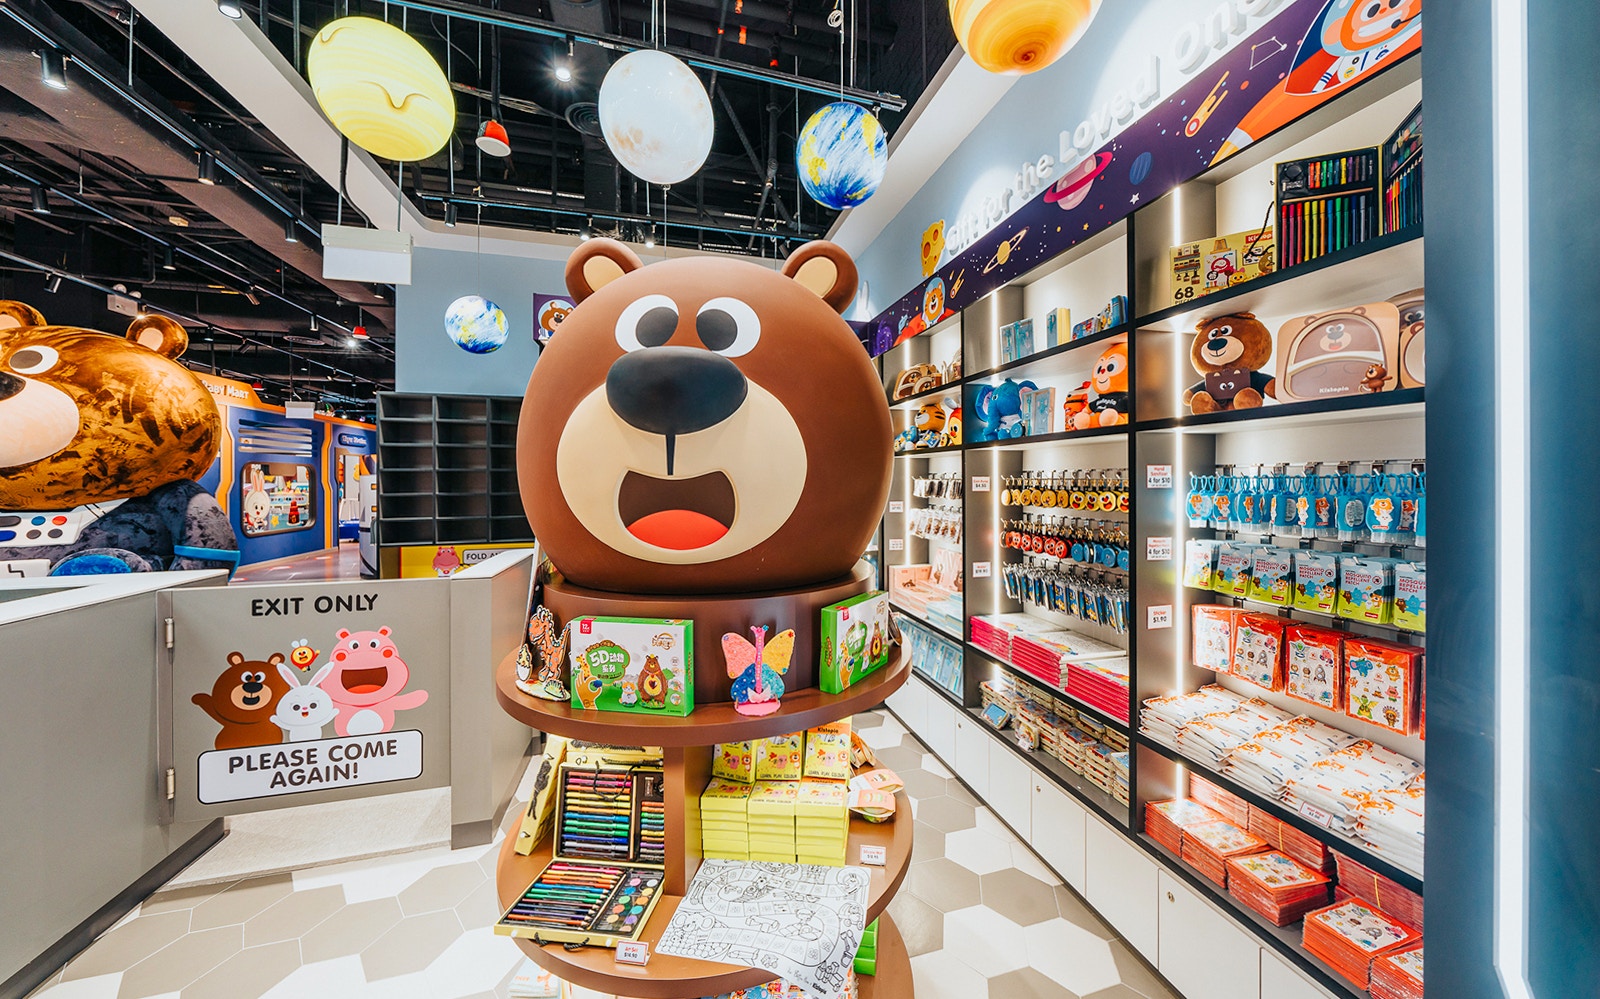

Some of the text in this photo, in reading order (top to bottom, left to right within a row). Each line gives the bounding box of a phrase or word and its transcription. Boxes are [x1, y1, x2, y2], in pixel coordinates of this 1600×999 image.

[981, 187, 1014, 230] for
[1014, 154, 1055, 201] the
[1058, 55, 1160, 163] Loved
[1174, 286, 1195, 300] 68
[251, 593, 379, 616] EXIT ONLY
[229, 739, 398, 774] PLEASE COME
[270, 763, 359, 789] AGAIN!
